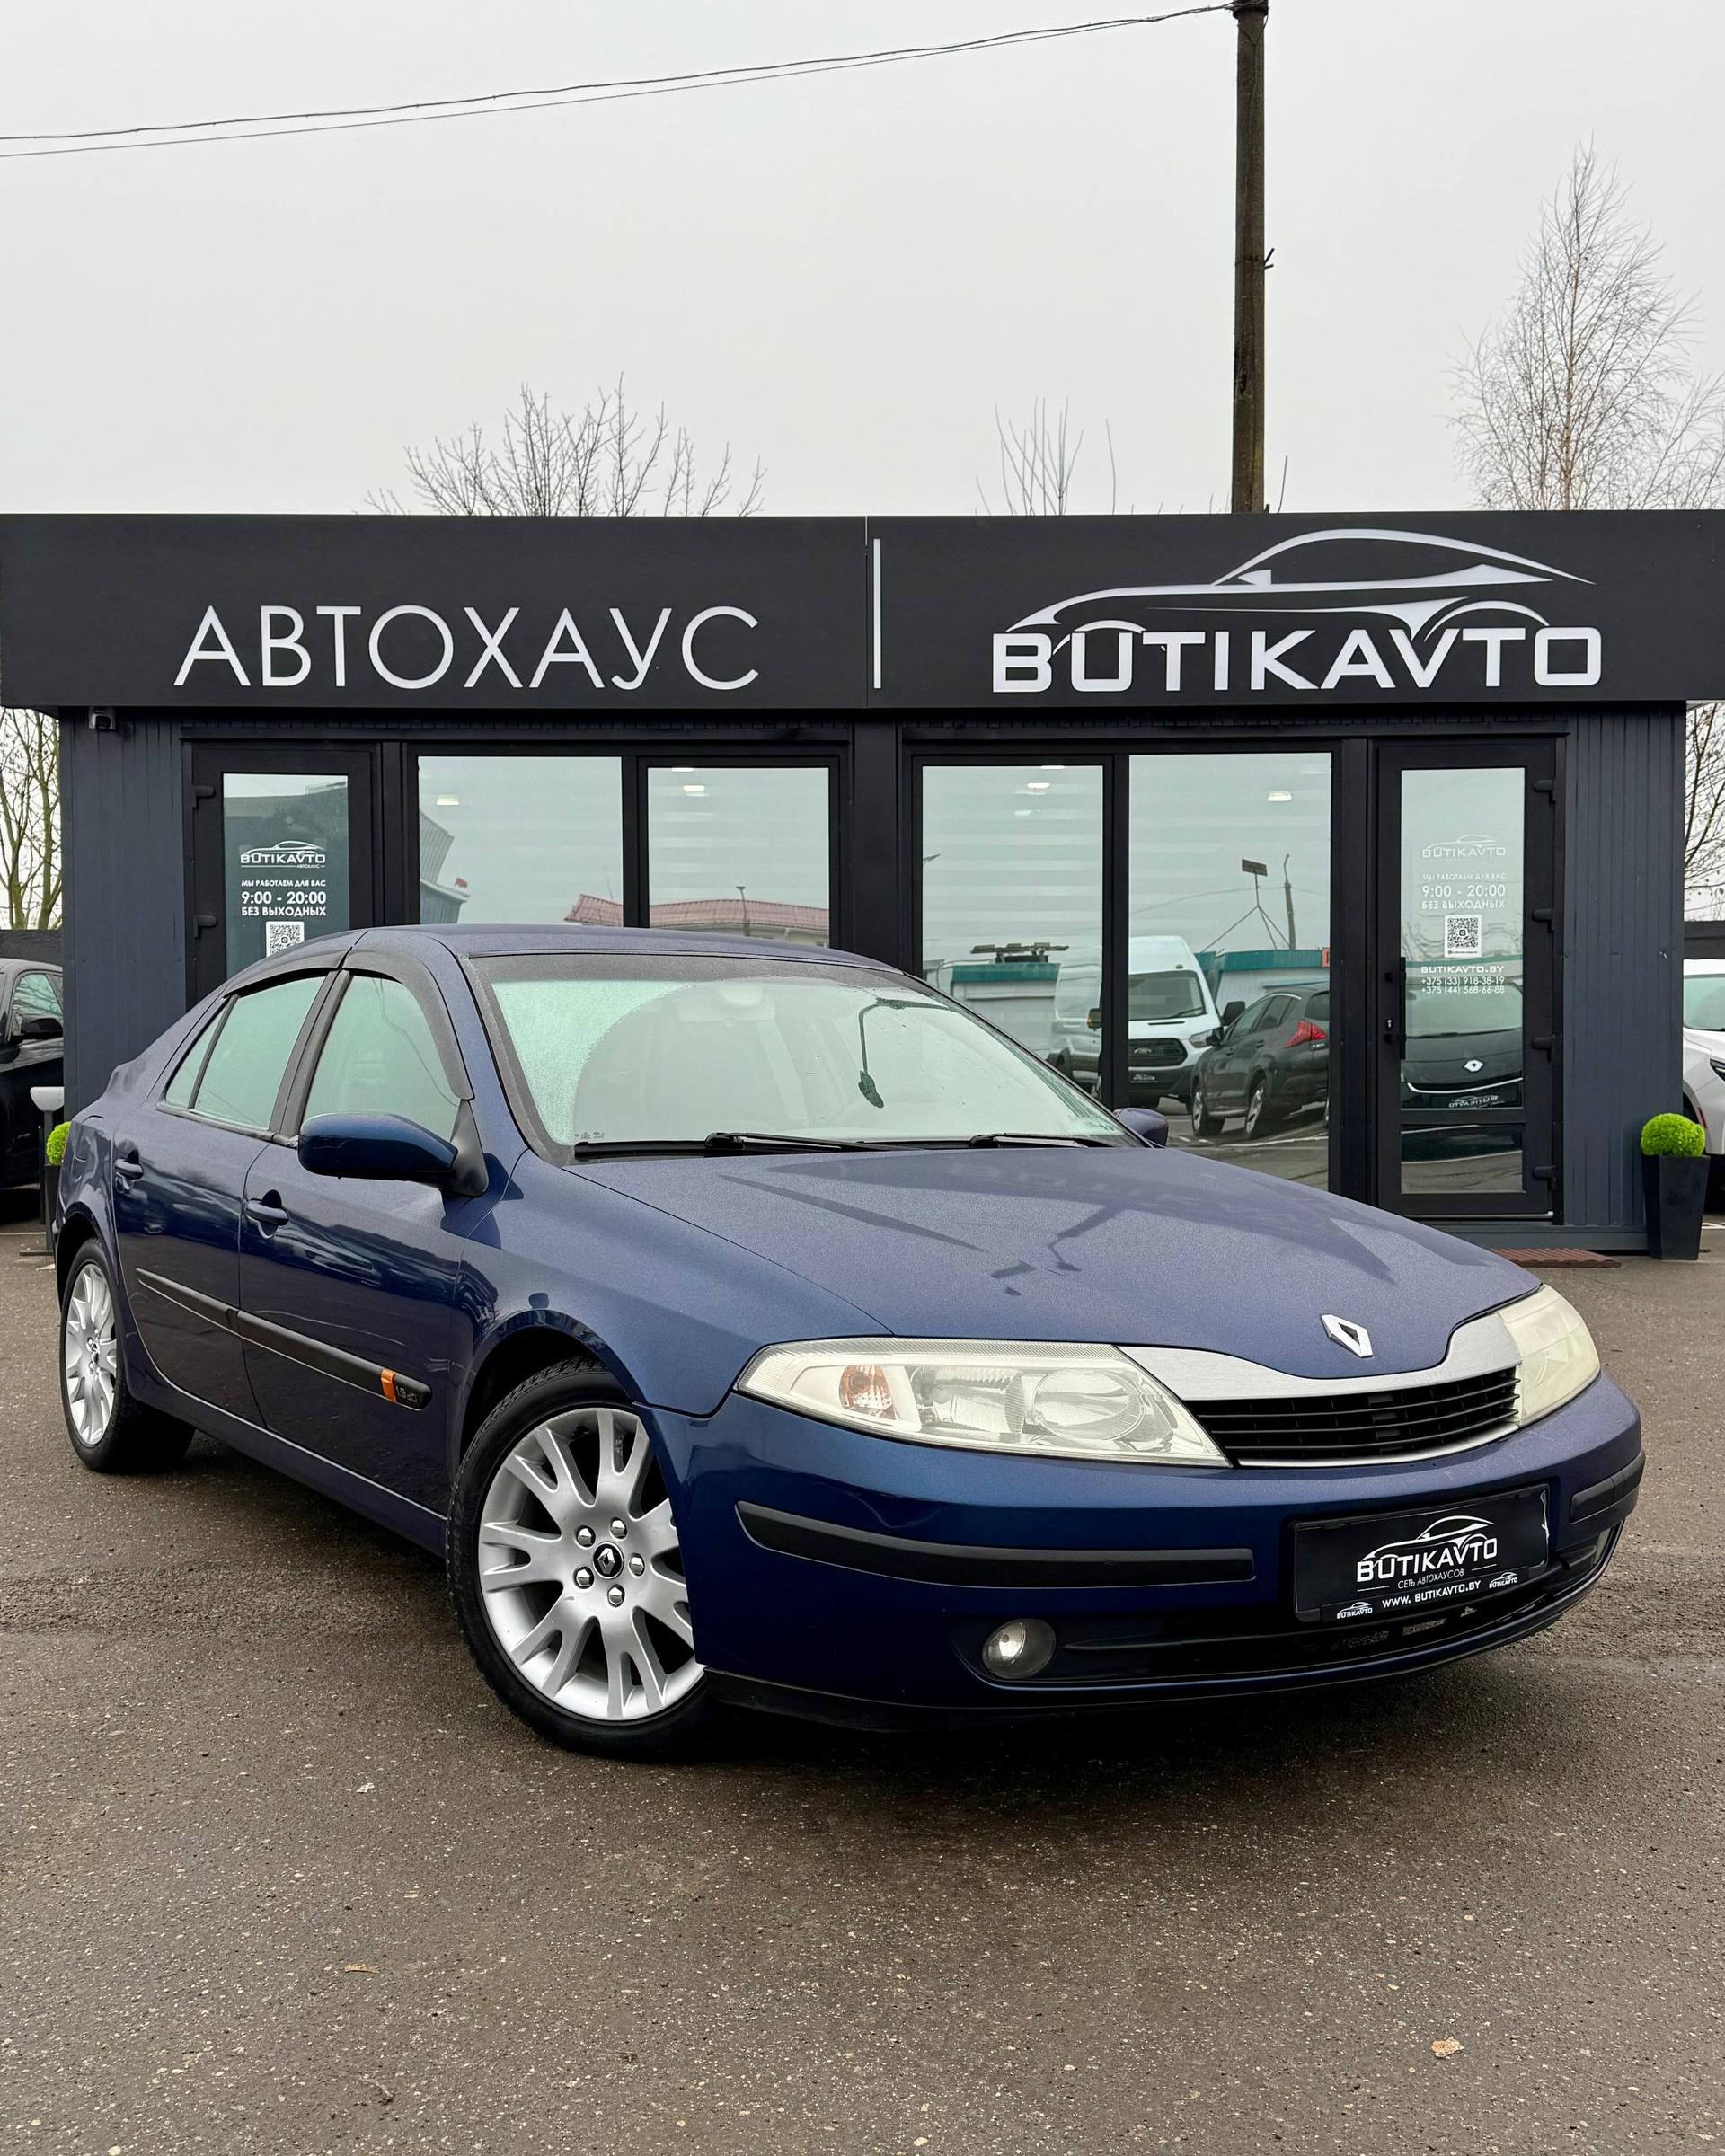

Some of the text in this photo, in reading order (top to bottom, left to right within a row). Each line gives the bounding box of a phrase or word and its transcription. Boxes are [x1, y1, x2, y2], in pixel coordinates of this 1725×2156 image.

[174, 605, 758, 691] АВТОХАУС
[993, 627, 1602, 693] BUTIKAVTO
[240, 853, 326, 863] BUTIKAVTO
[1422, 847, 1506, 857] BUTIKAVTO
[241, 879, 326, 888] МЫ РАБОТАЕМ ДЛЯ ВАС
[1422, 885, 1452, 897] 9:00
[1466, 884, 1506, 897] 20:00
[241, 891, 272, 905] 9:00
[287, 891, 327, 905] 20:00
[1421, 899, 1506, 910] БЕЗ ВЫХОДНЫХ
[241, 906, 327, 917] БЕЗ ВЫХОДНЫХ
[1420, 965, 1504, 973] BUTIKAVTO.BY
[1421, 976, 1505, 986] +375 (33) 918-38-19
[1421, 985, 1442, 994] +375
[1357, 1538, 1498, 1582] BUTIKAVTO
[1397, 1568, 1464, 1589] СЕТЬ АВТОХАУСОВ
[1489, 1577, 1518, 1589] BUTIKAVTO
[1382, 1580, 1482, 1609] WWW. BUTIKAVTO.BY
[1336, 1607, 1373, 1619] BUTIKAVTO
